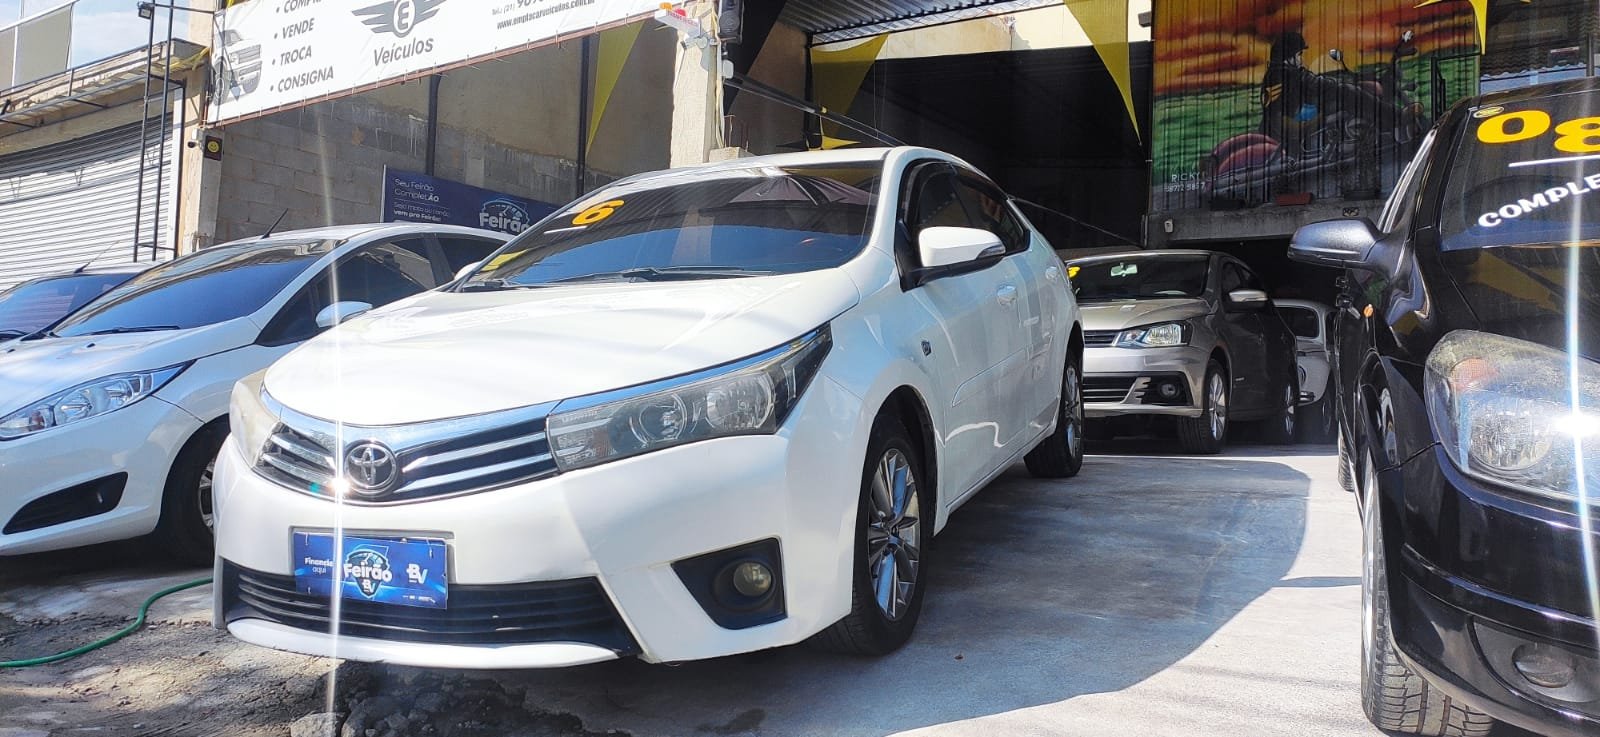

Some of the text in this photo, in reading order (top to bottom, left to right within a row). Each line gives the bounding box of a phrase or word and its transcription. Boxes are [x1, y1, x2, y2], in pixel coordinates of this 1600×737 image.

[284, 0, 321, 13] COMP
[282, 17, 315, 39] VENDE
[280, 45, 312, 66] TROCA
[374, 35, 435, 67] Veículos
[278, 65, 334, 93] CONSIGNA
[394, 178, 435, 192] Seu Feirão
[1171, 171, 1200, 182] RICKY
[393, 209, 408, 217] vem
[479, 210, 530, 233] Feirão
[312, 566, 327, 574] aqui
[343, 561, 393, 582] Feirão
[406, 563, 428, 584] BV
[361, 578, 376, 594] BV
